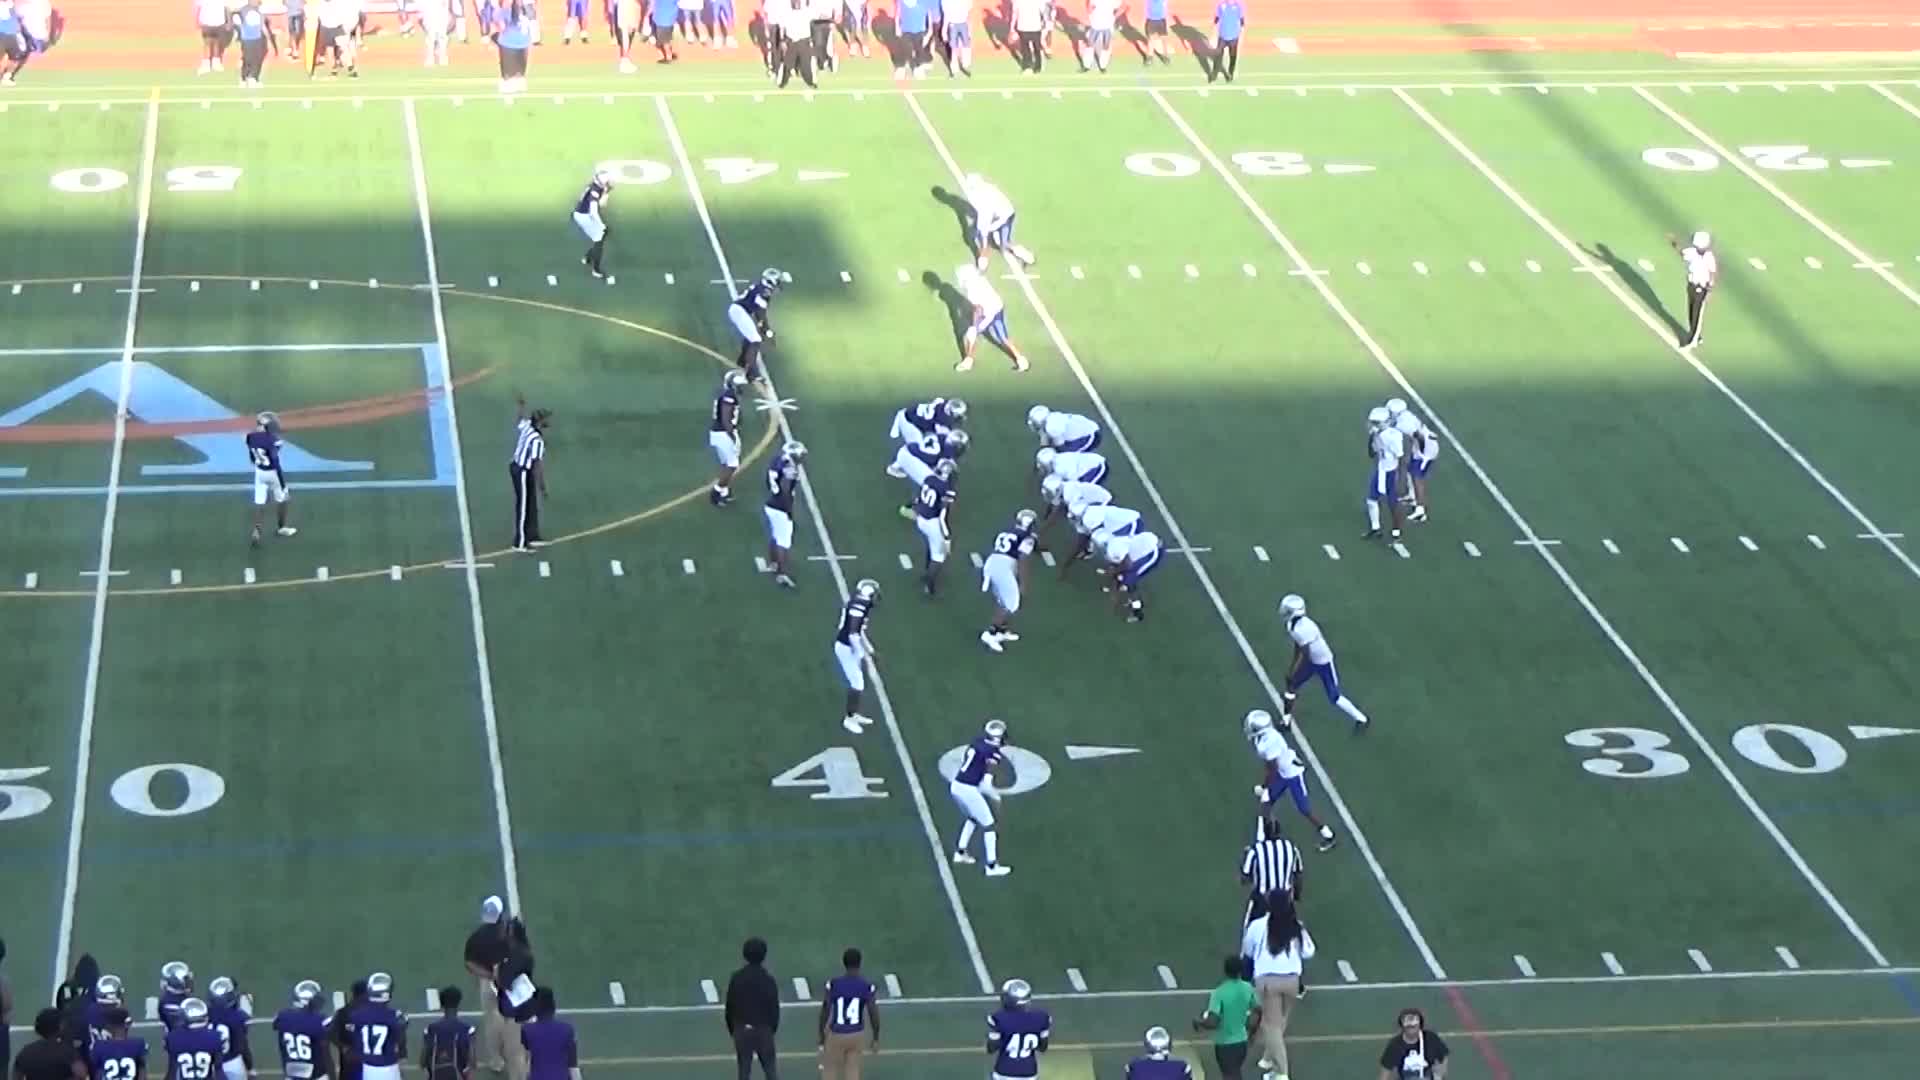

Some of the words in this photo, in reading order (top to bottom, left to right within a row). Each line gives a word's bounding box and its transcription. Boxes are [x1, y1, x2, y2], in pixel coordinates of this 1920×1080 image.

[1564, 726, 1847, 777] 30
[771, 746, 1051, 795] 40
[837, 996, 860, 1025] 14
[283, 1031, 312, 1060] 26
[361, 1024, 388, 1055] 17
[104, 1057, 136, 1080] 23
[177, 1051, 211, 1079] 29
